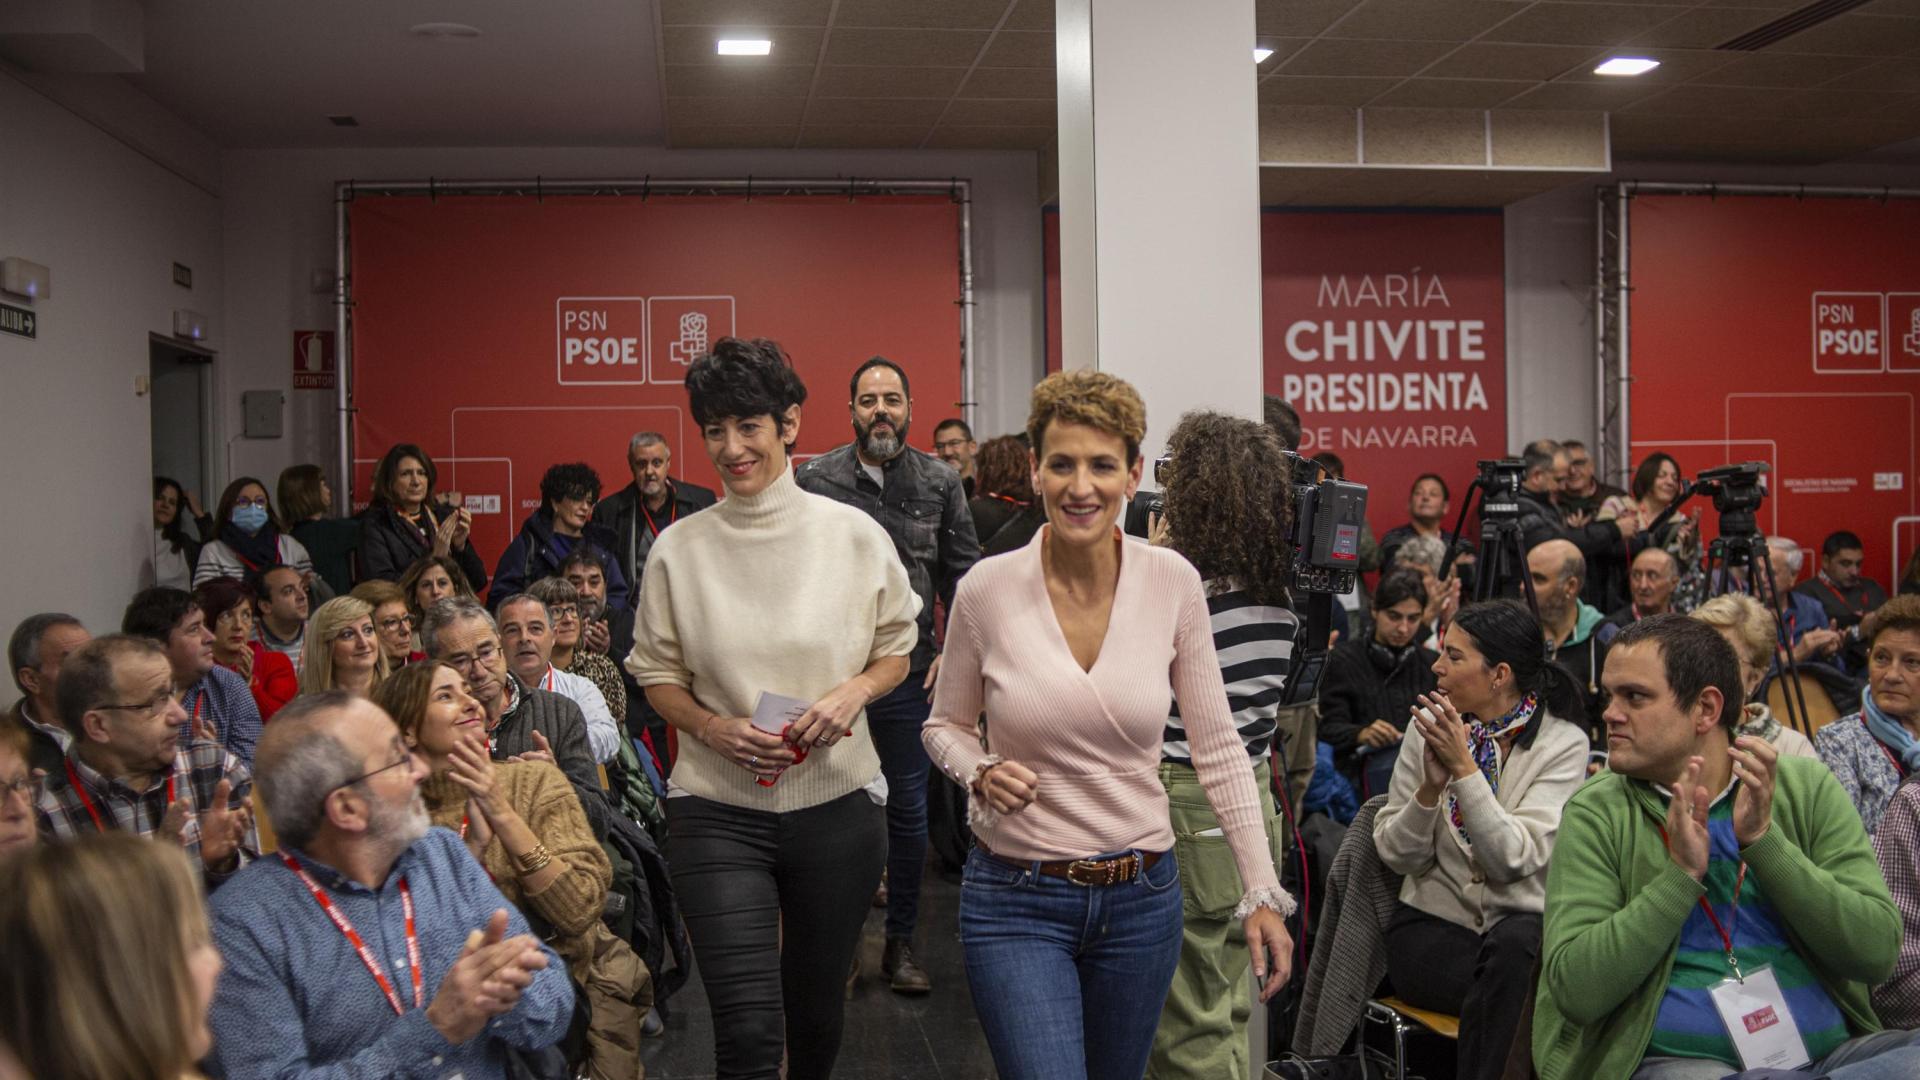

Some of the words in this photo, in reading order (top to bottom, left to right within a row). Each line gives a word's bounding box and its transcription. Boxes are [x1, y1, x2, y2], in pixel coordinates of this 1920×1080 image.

[1316, 266, 1451, 308] MARÍA
[0, 308, 23, 331] ALIDA
[565, 311, 607, 331] PSN
[1819, 304, 1854, 324] PSN
[565, 337, 638, 365] PSOE
[1285, 320, 1486, 361] CHIVITE
[1820, 330, 1878, 354] PSOE
[294, 375, 335, 387] EXTINTOR
[1283, 371, 1489, 412] PRESIDENTA
[1296, 427, 1333, 450] DE
[1341, 425, 1477, 449] NAVARRA
